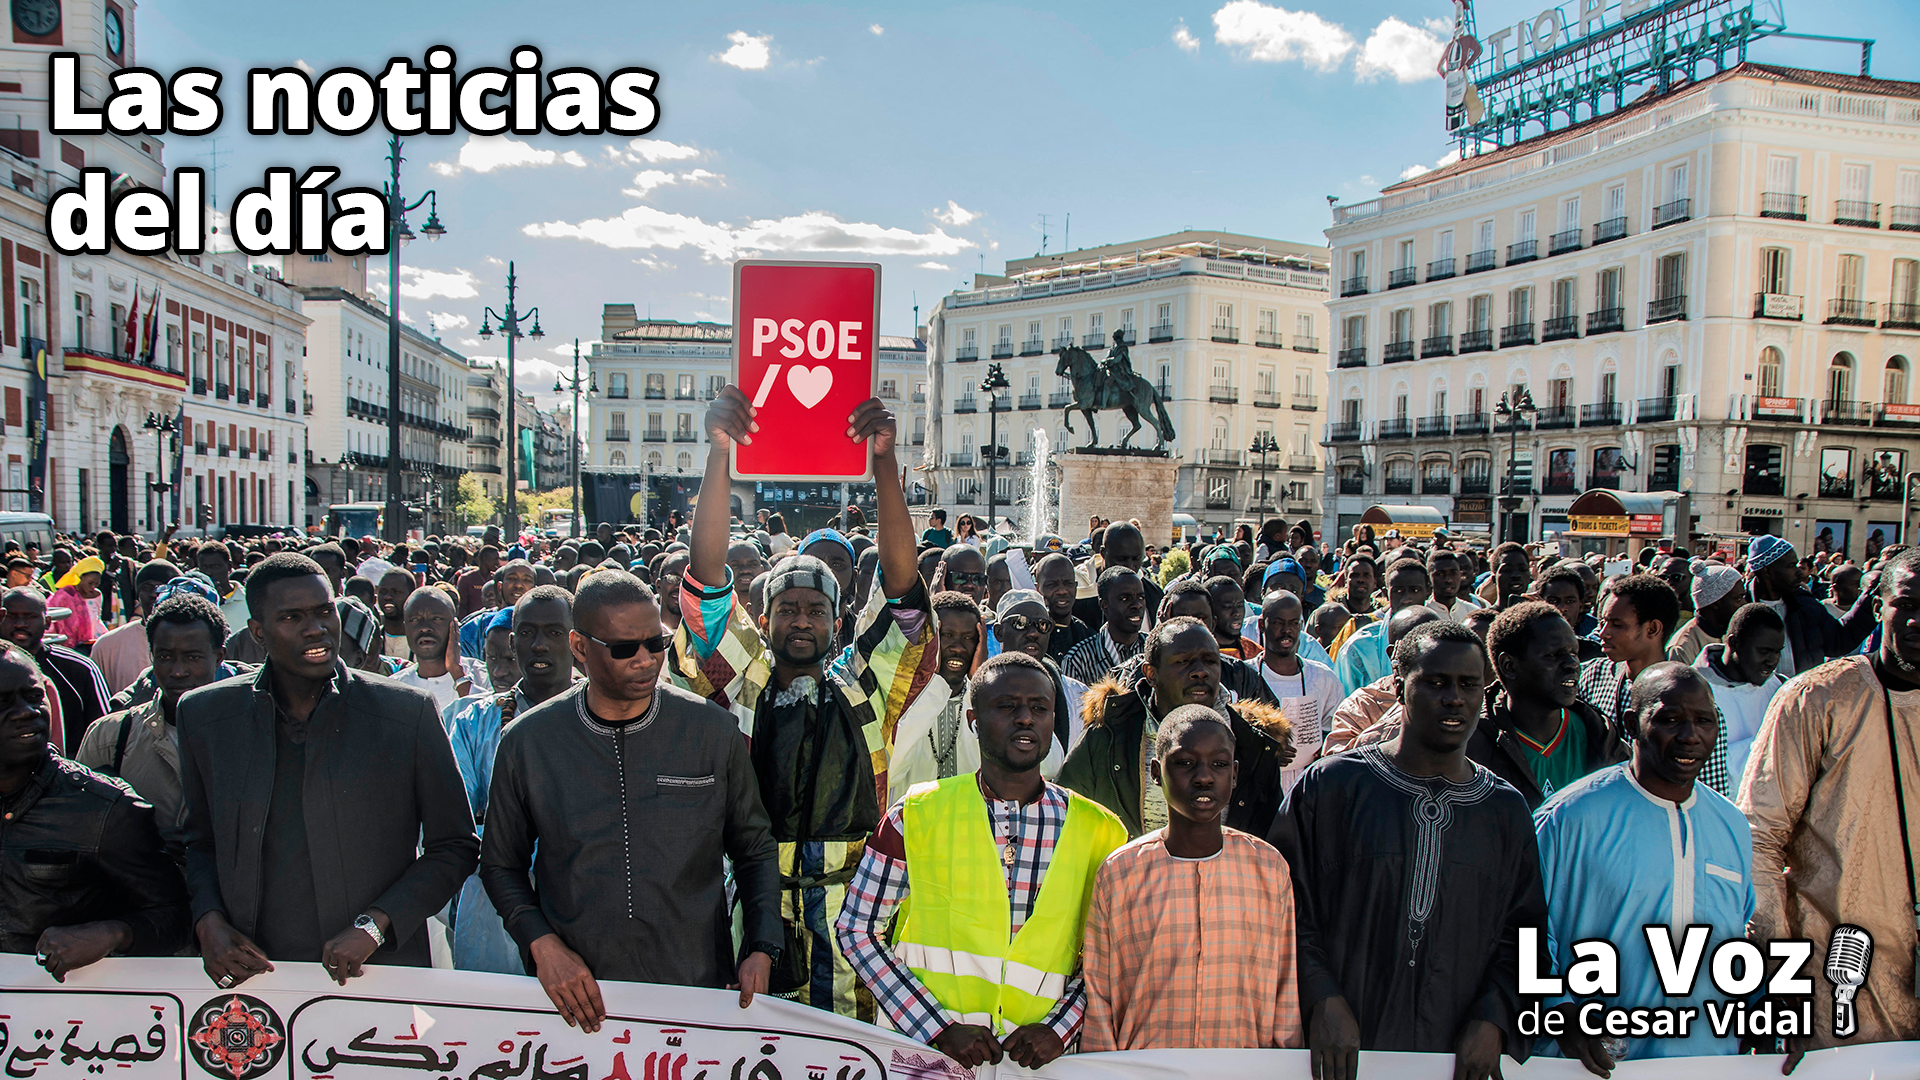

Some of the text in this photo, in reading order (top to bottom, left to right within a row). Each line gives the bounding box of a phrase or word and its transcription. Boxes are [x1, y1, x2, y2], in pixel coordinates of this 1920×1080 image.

[1487, 8, 1561, 71] TIO
[1650, 5, 1753, 70] BYASS
[1484, 78, 1509, 97] SOL
[1536, 34, 1616, 77] ANDALUCIA
[752, 317, 863, 361] PSOE
[1578, 521, 1593, 530] TOURS
[1598, 521, 1618, 531] TICKETS
[1744, 506, 1784, 516] SEPHORA
